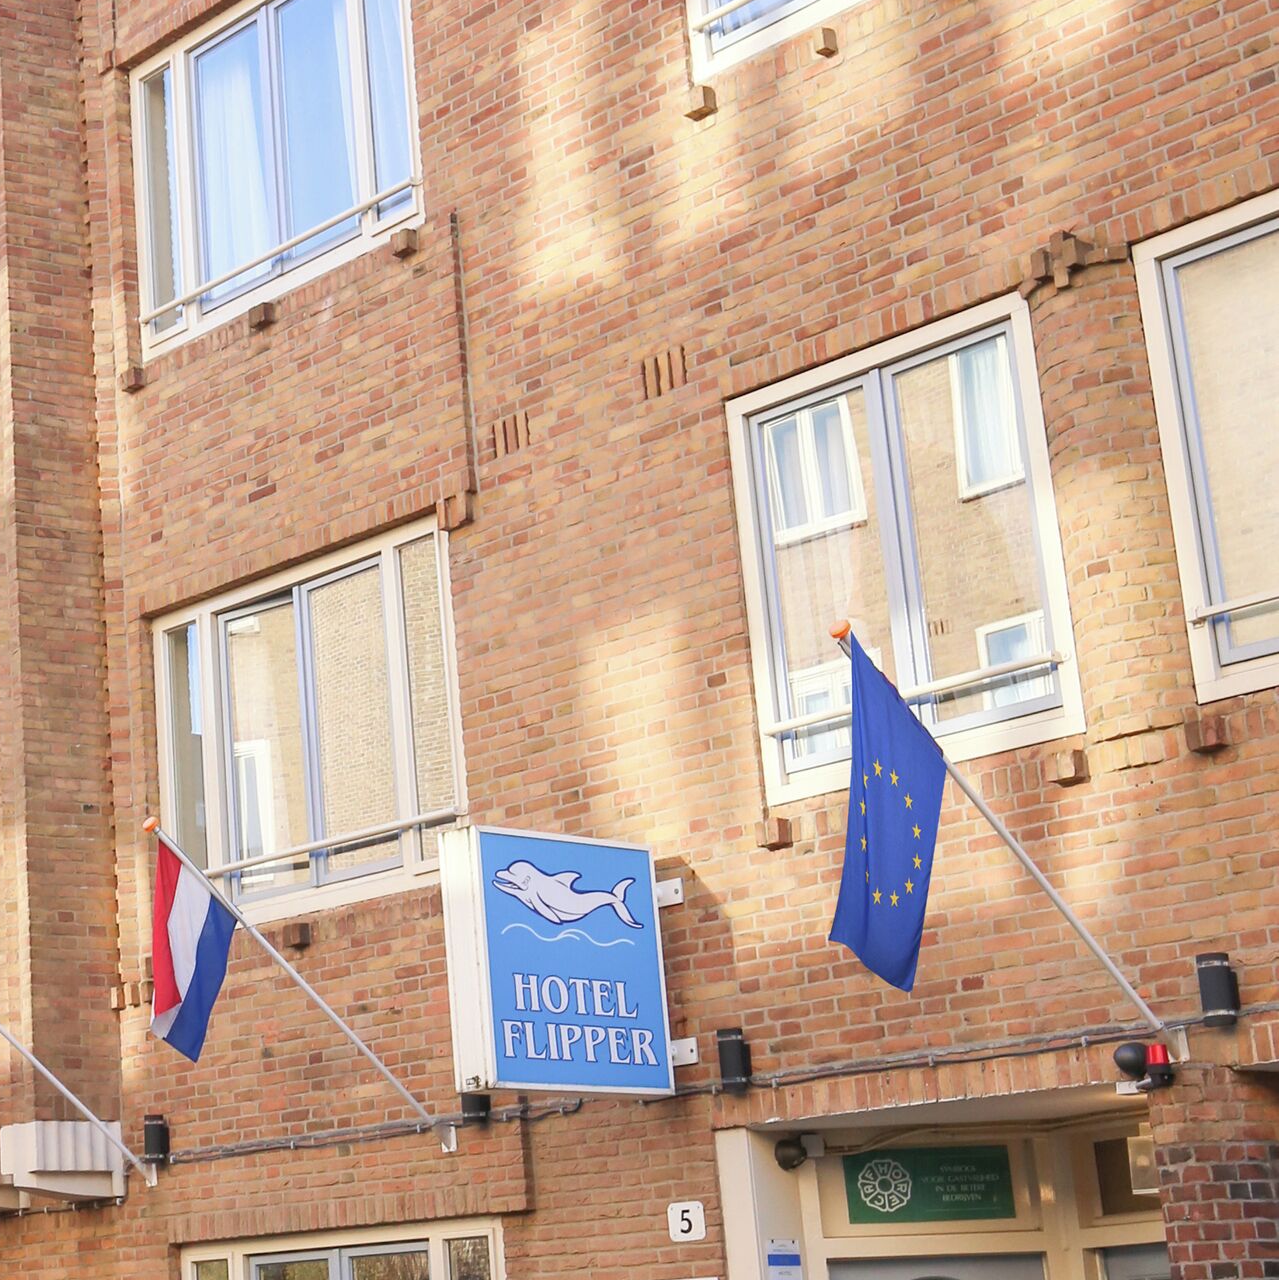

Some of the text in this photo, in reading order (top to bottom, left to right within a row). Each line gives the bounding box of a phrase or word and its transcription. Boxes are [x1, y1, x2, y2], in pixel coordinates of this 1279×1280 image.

[512, 973, 639, 1019] HOTEL
[501, 1019, 660, 1066] FLIPPER
[680, 1209, 693, 1234] 5
